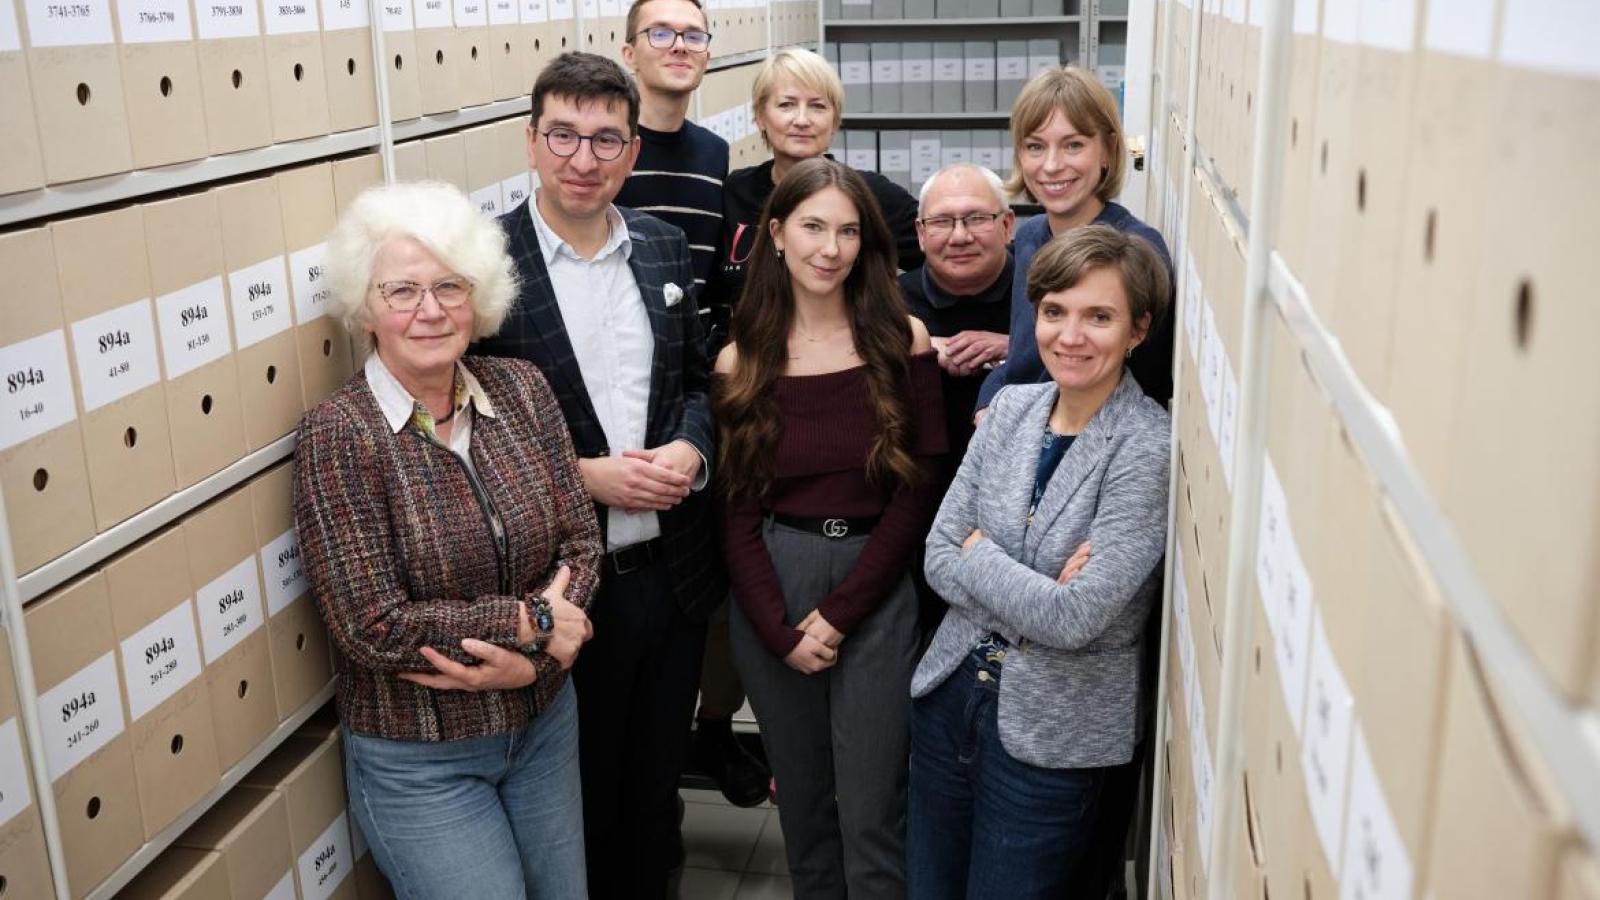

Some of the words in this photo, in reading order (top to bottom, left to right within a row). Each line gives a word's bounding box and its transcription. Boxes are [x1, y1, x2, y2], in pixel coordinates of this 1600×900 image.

[248, 281, 272, 302] 894a
[180, 304, 208, 327] 894a
[97, 329, 131, 354] 894a
[7, 366, 45, 394] 894a
[109, 361, 130, 378] 41-80
[20, 402, 44, 421] 16-40
[219, 588, 245, 614] 894a
[145, 637, 175, 665] 894a
[149, 660, 177, 686] 261-280
[61, 691, 97, 723] 894a
[67, 719, 100, 749] 241-260
